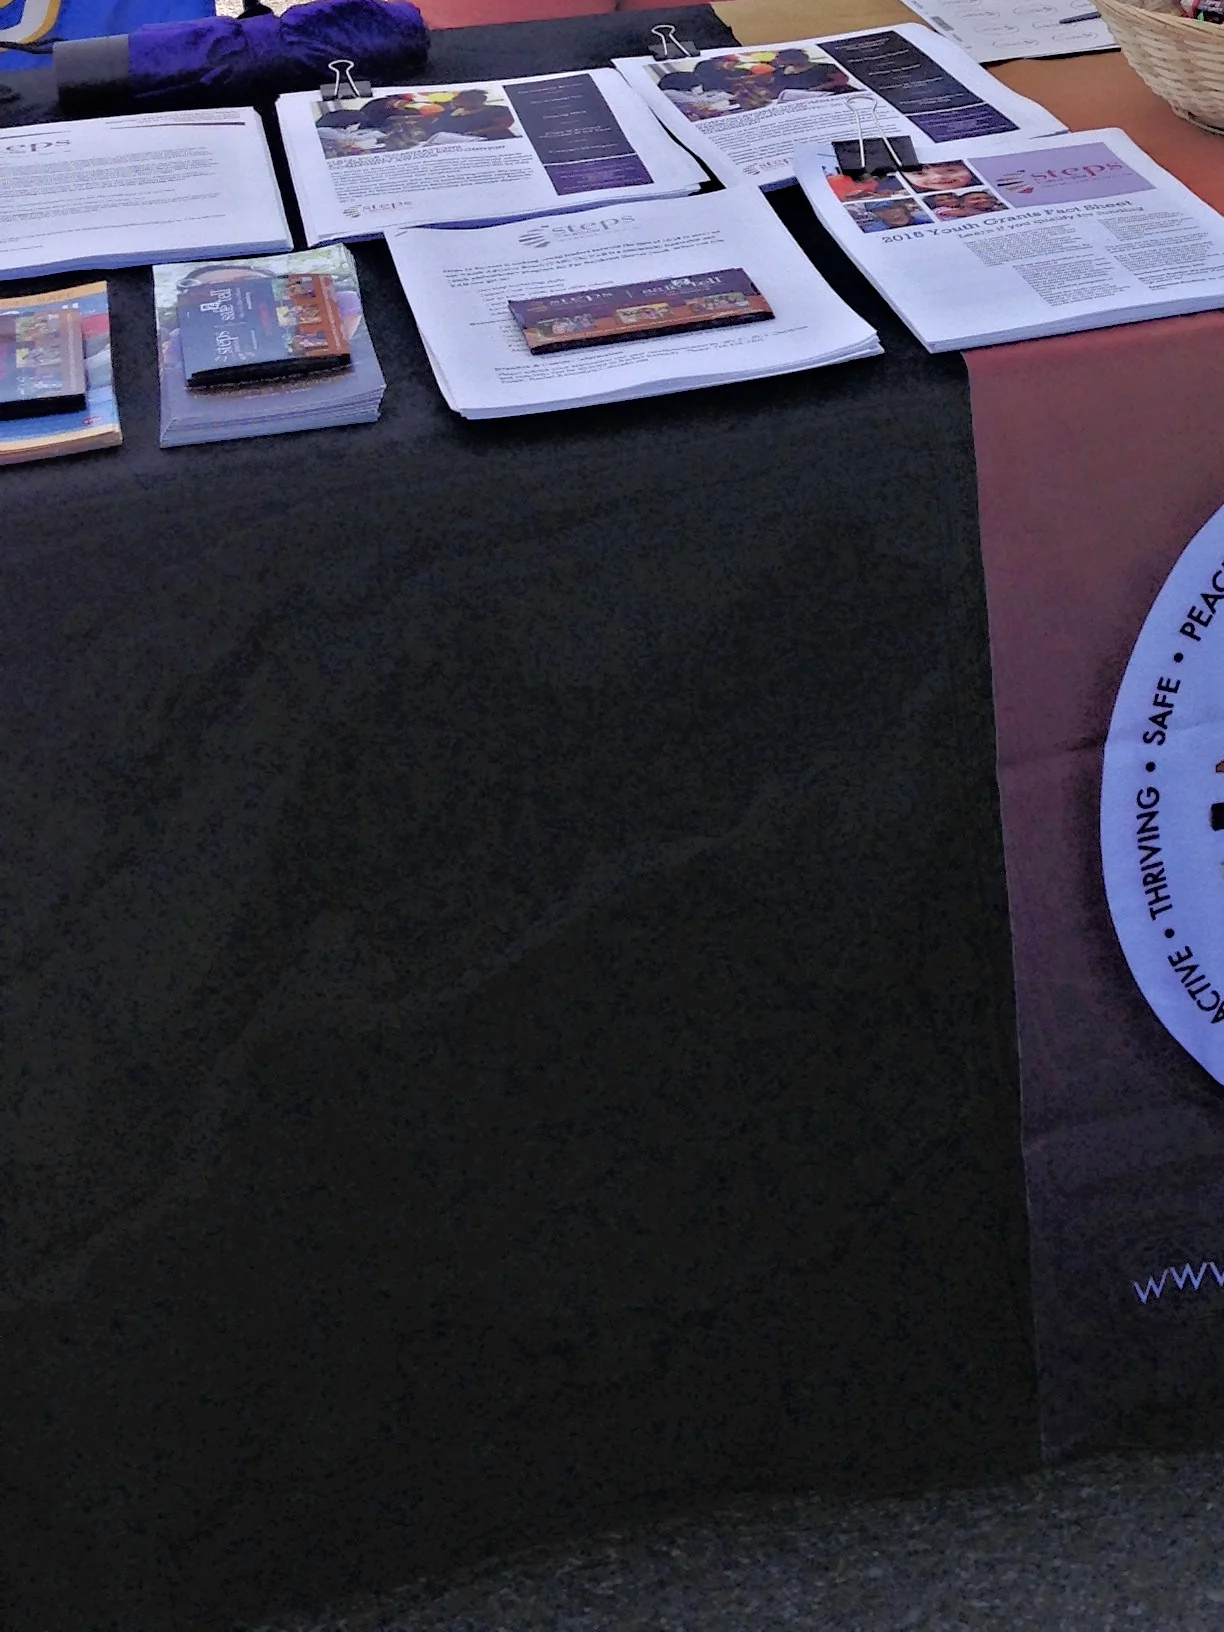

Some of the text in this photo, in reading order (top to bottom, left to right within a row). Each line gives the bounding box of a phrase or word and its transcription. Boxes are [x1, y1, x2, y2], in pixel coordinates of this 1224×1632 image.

[1031, 162, 1123, 184] steps
[552, 215, 636, 235] steps
[928, 221, 981, 237] Youth
[983, 209, 1042, 227] Grants
[1043, 204, 1081, 218] Fact
[1082, 199, 1134, 213] Sheet
[1144, 675, 1182, 746] SAFE
[1136, 785, 1165, 922] THRIVING
